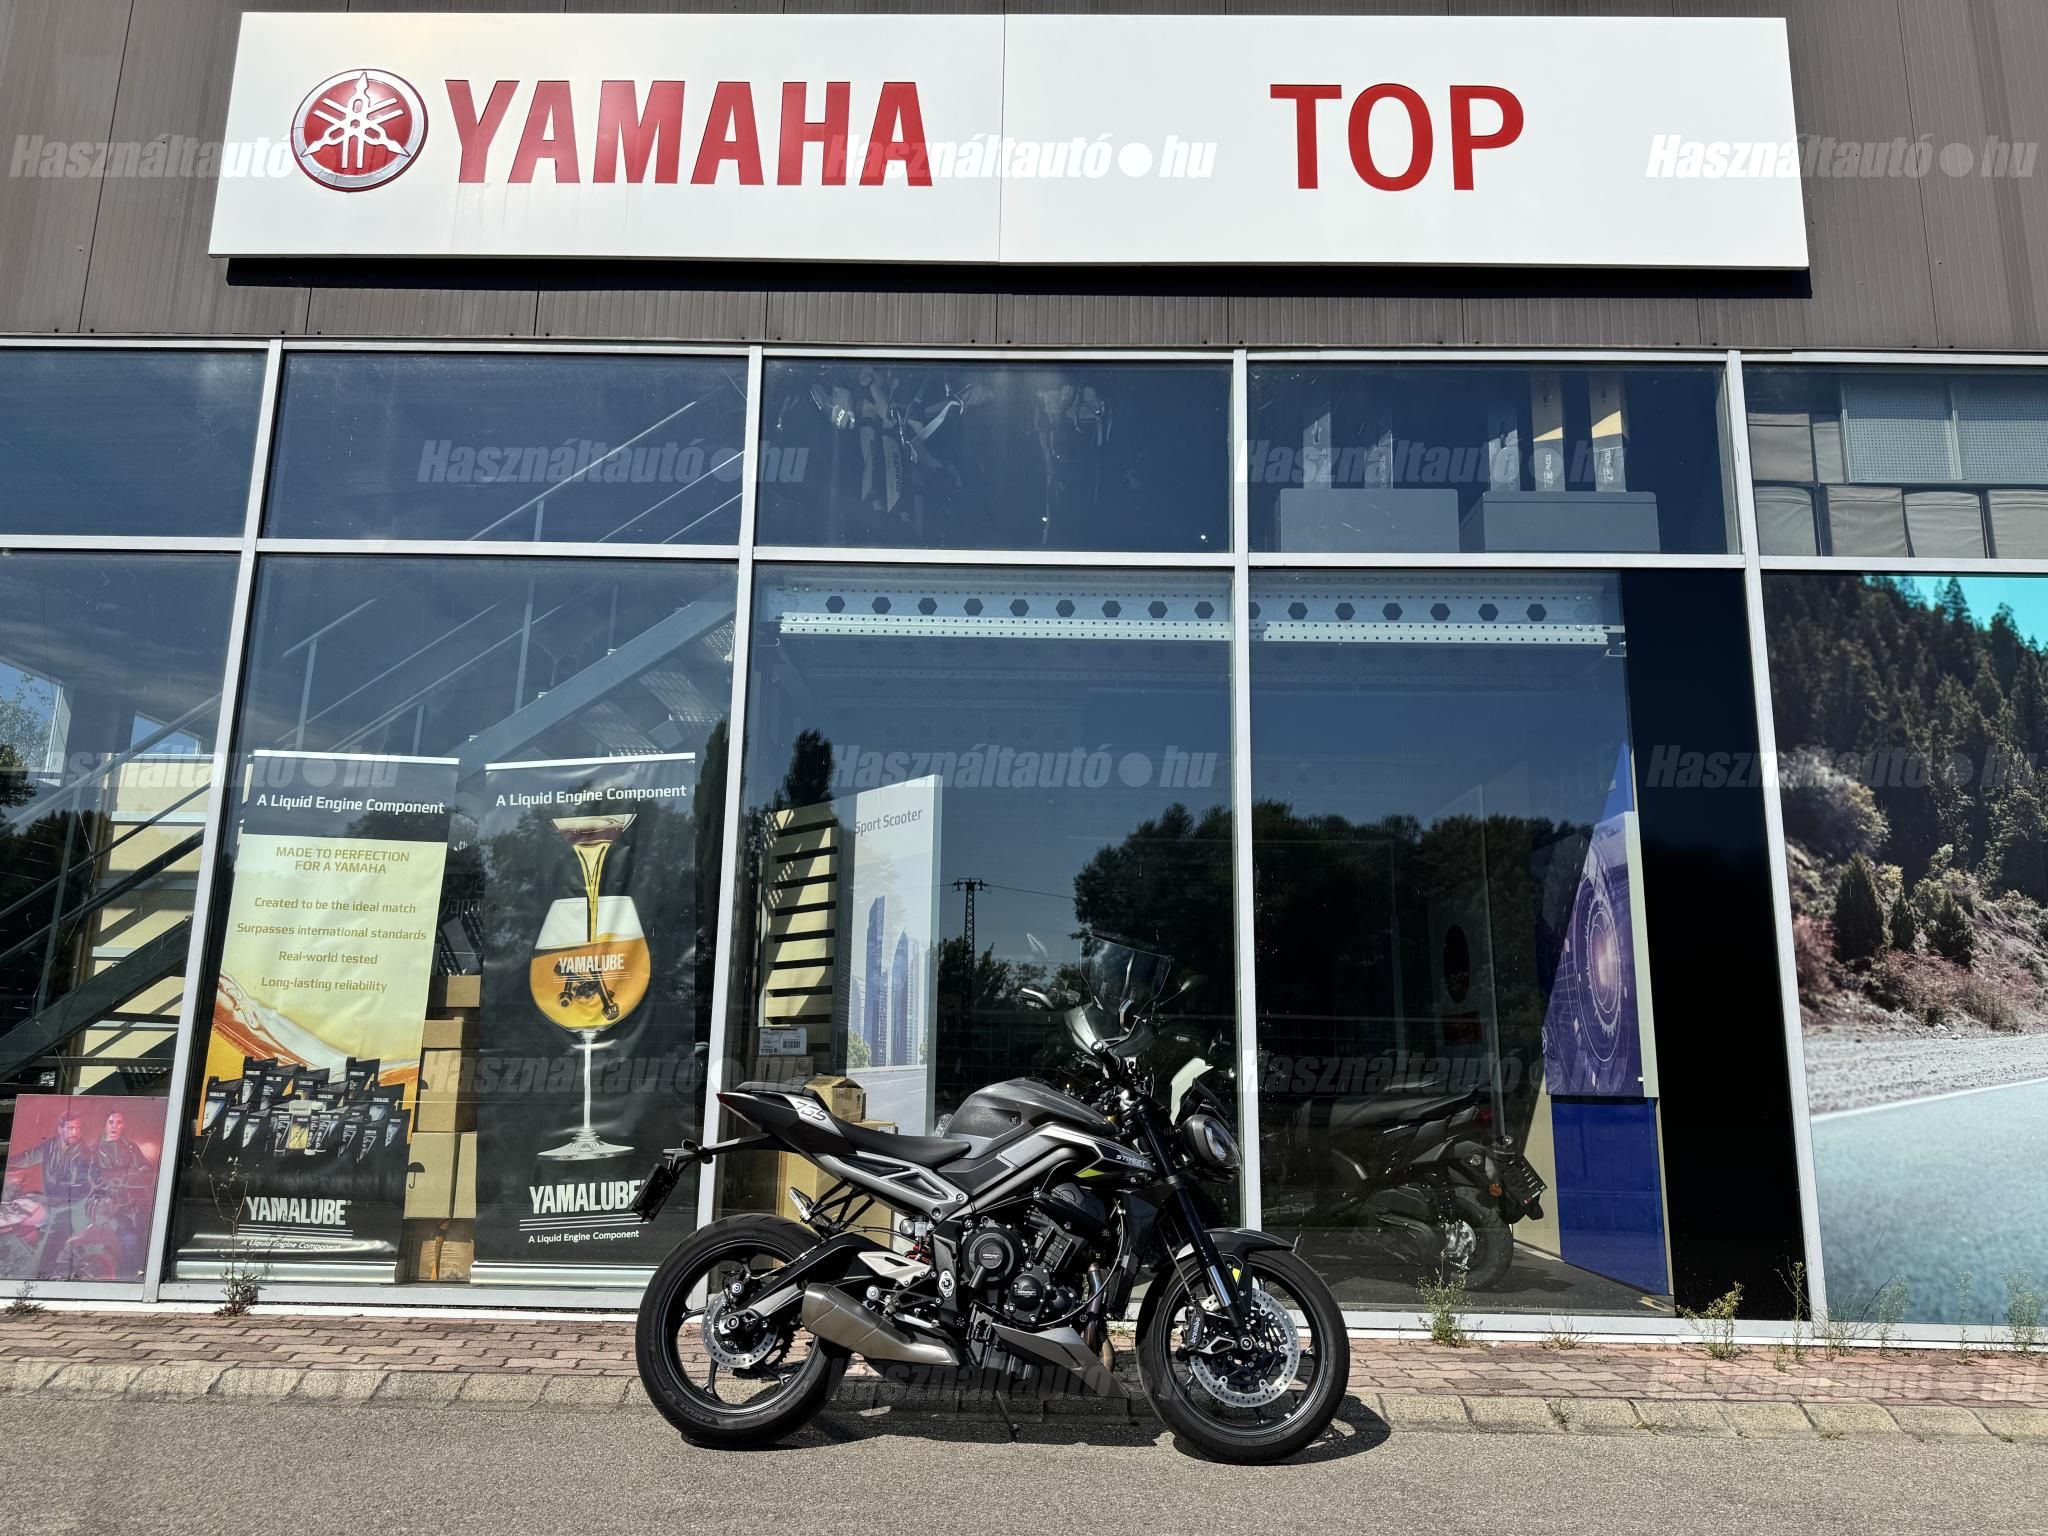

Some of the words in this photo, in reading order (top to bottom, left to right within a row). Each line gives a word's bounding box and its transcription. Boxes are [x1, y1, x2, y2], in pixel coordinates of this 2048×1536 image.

[445, 80, 933, 186] YAMAHA
[1270, 82, 1524, 191] TOP
[257, 794, 267, 806] A
[271, 794, 312, 810] Liquid
[316, 797, 362, 812] Engine
[366, 799, 445, 815] Component
[496, 795, 506, 807] A
[510, 792, 552, 809] Liquid
[556, 789, 603, 806] Engine
[606, 784, 687, 802] Component
[855, 815, 881, 837] Sport
[883, 808, 923, 828] Scooter
[276, 847, 312, 858] MADE
[316, 848, 331, 859] TO
[334, 849, 410, 862] PERFECTION
[295, 861, 320, 871] FOR
[323, 862, 331, 872] A
[335, 863, 387, 874] YAMAHA
[254, 897, 298, 909] Created
[301, 900, 313, 909] to
[316, 899, 328, 910] be
[331, 900, 349, 911] the
[352, 901, 379, 912] ideal
[382, 902, 416, 914] match
[237, 923, 295, 936] Surpasses
[297, 925, 368, 938] international
[371, 928, 427, 941] standards
[279, 951, 338, 963] Real-world
[341, 953, 378, 965] tested
[558, 953, 625, 973] YAMALUBE
[261, 977, 332, 992] Long-lasting
[334, 979, 388, 993] reliability
[246, 1196, 347, 1225] YAMALUBE
[537, 1234, 561, 1245] Liquid
[564, 1232, 590, 1243] Engine
[592, 1230, 639, 1242] Component
